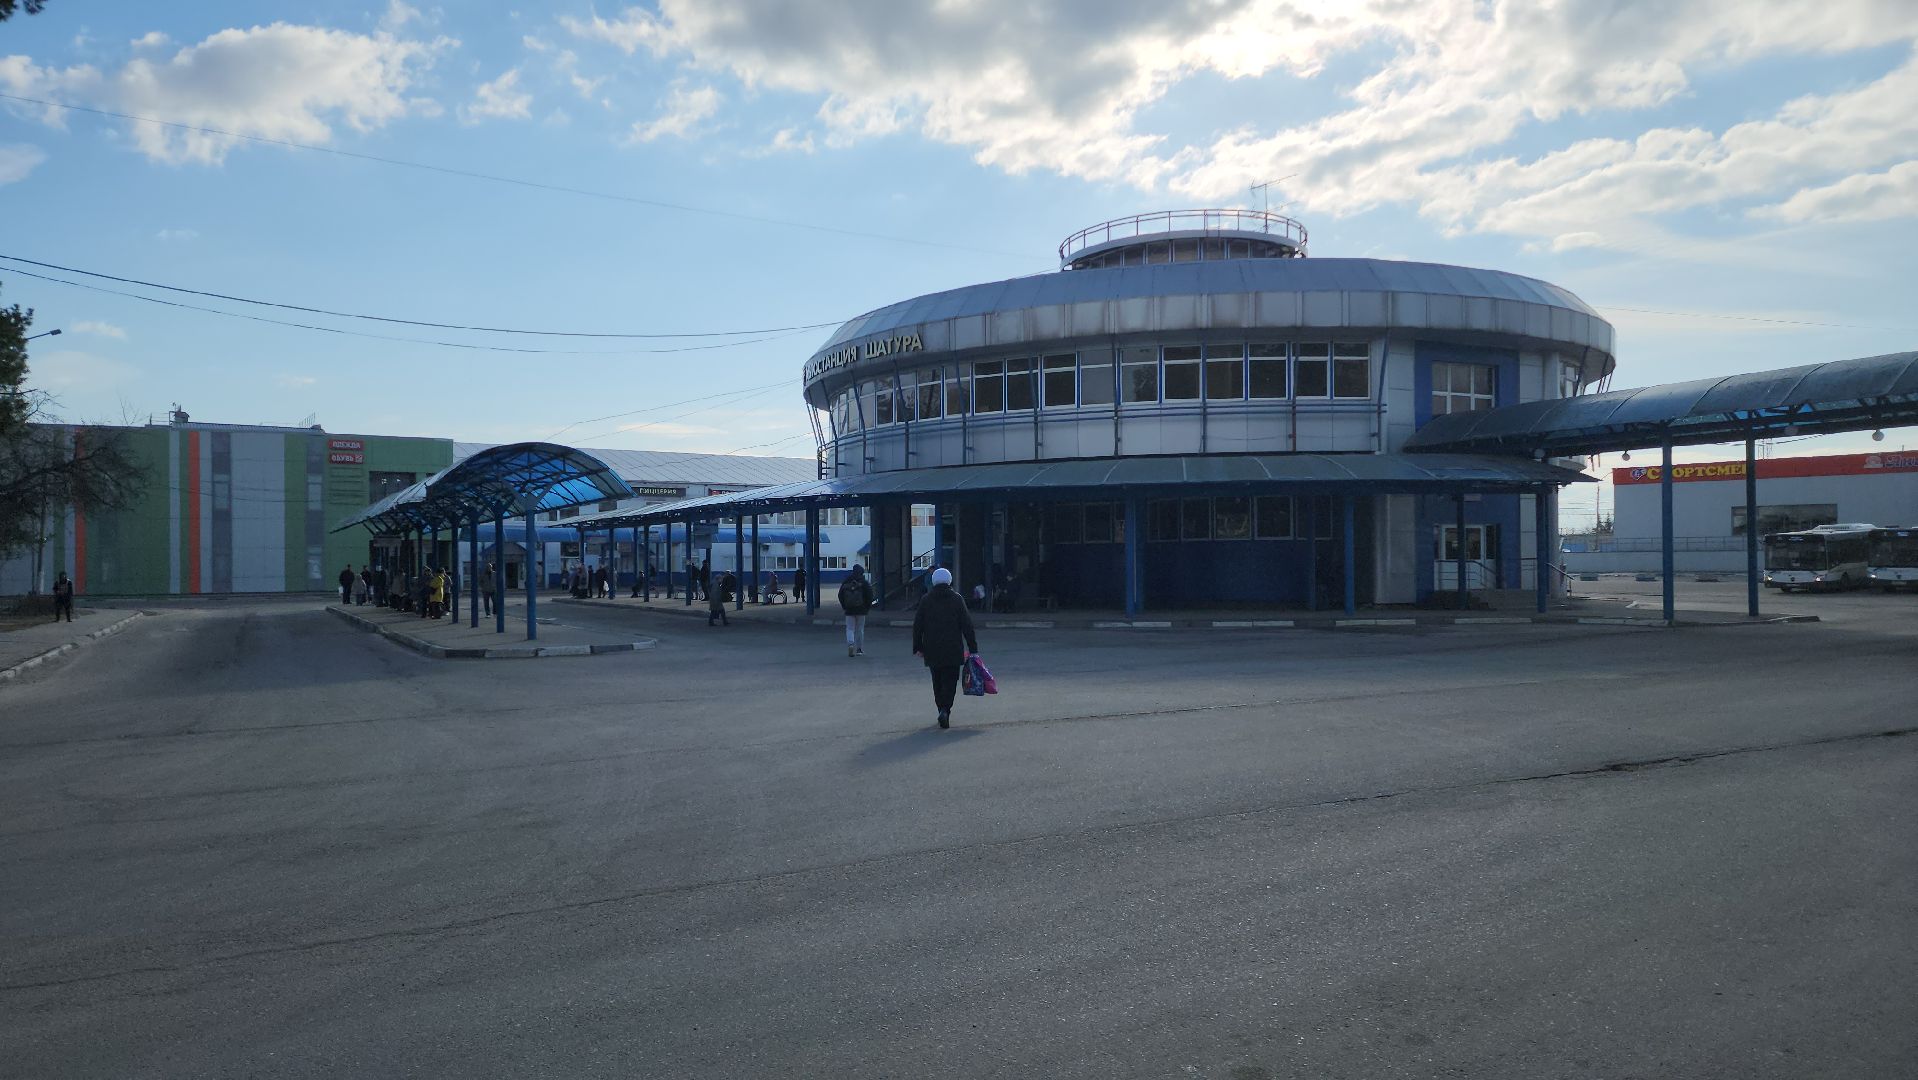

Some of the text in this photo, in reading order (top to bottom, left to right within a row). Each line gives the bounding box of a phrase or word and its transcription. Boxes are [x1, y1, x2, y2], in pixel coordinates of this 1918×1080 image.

[864, 332, 923, 359] ШАТУРА
[1646, 464, 1747, 480] СОРТСМЕ
[639, 487, 677, 495] ПИЦЦЕРИЯ
